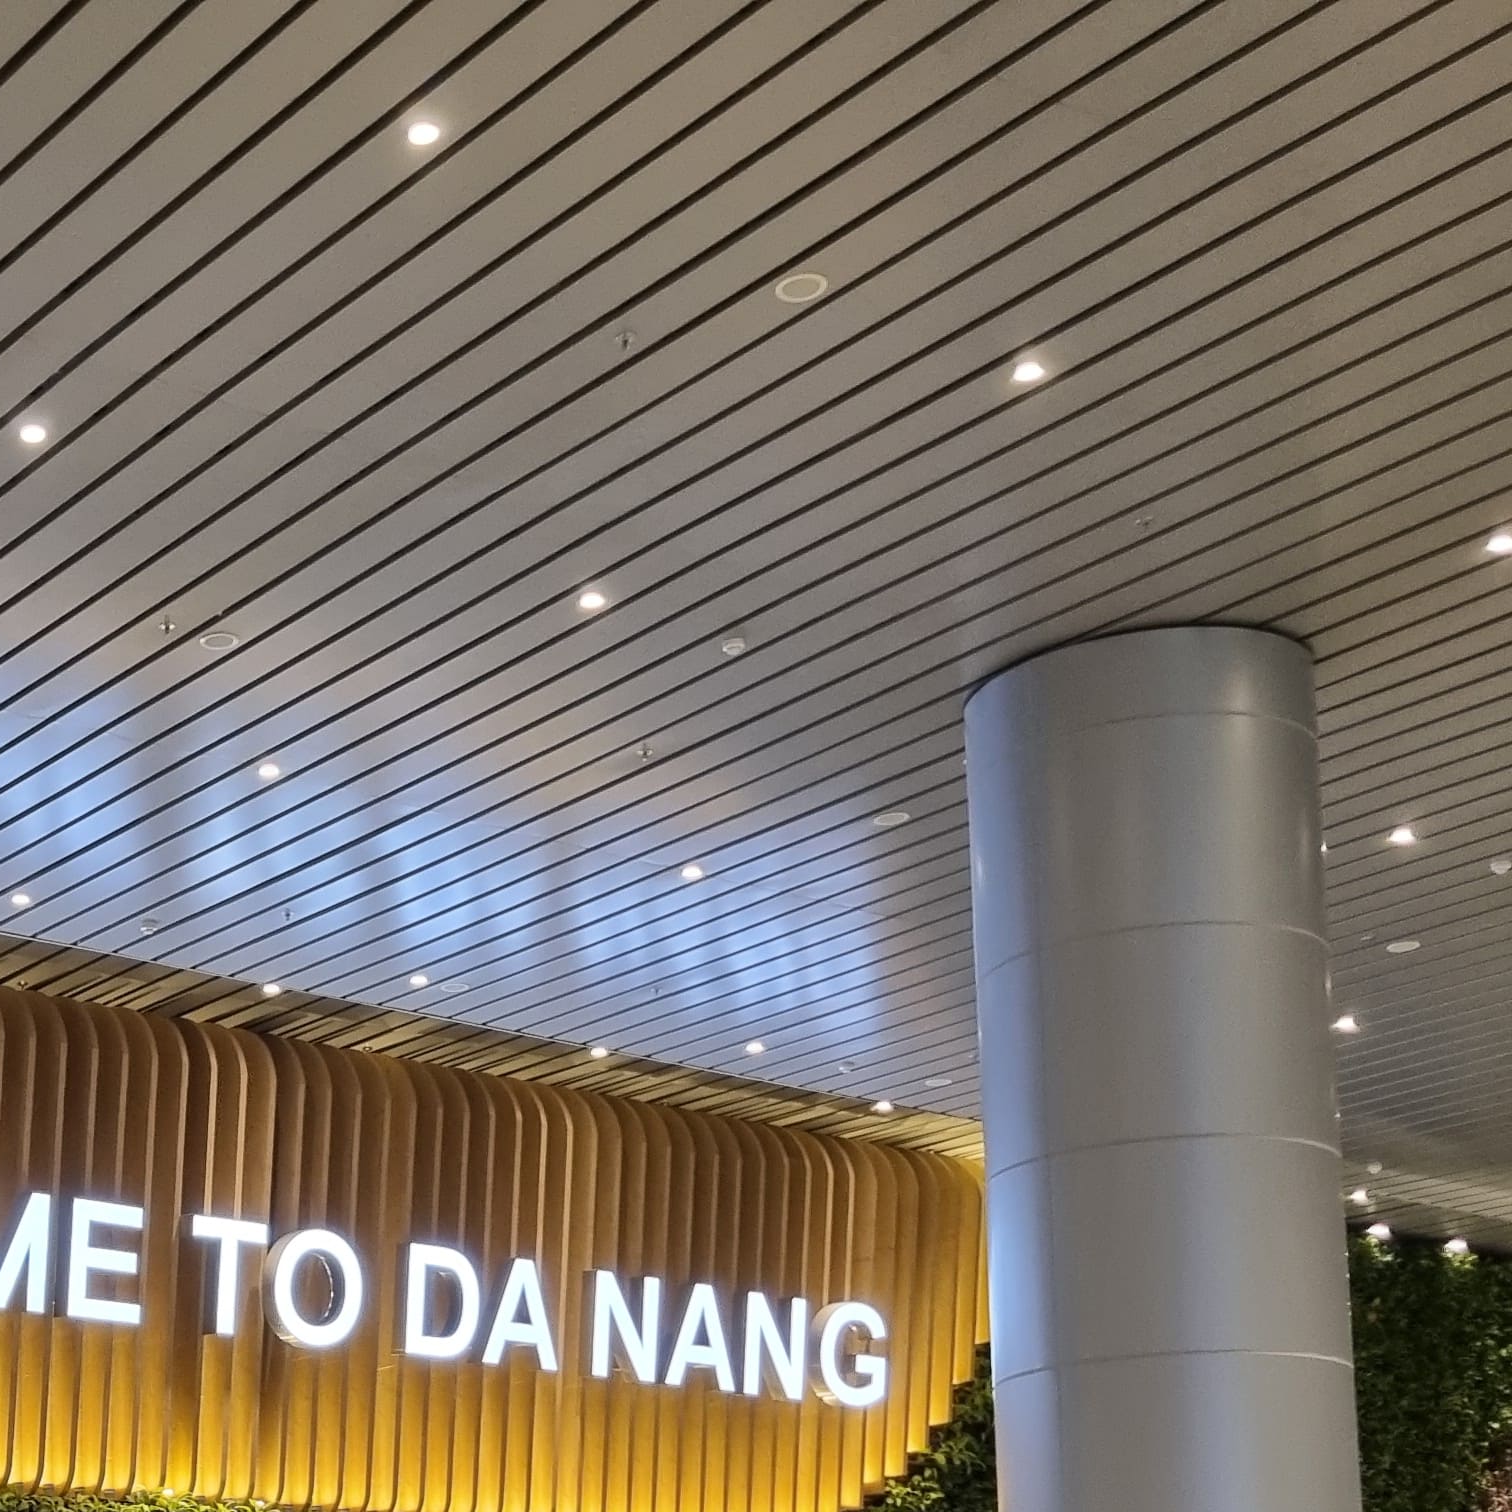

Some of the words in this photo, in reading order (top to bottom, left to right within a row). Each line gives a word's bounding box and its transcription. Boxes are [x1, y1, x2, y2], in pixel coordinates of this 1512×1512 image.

[191, 1214, 363, 1348] TO
[404, 1242, 559, 1371] DA
[590, 1269, 887, 1408] NANG
